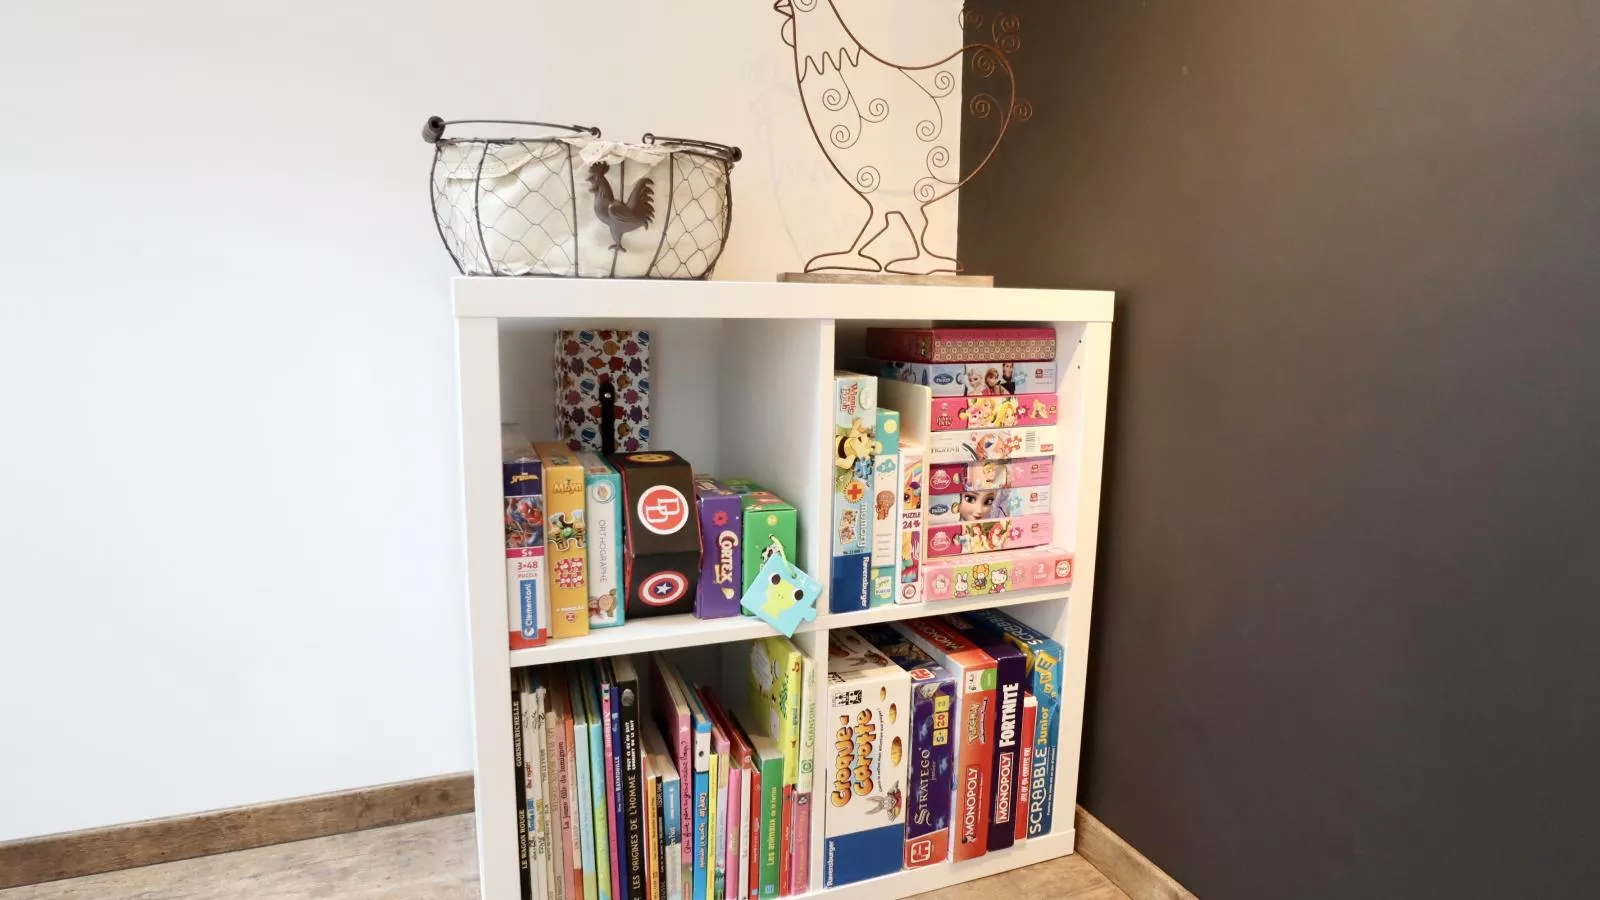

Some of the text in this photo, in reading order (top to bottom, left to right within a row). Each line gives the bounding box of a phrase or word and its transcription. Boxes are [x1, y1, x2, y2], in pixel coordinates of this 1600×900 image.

[903, 521, 912, 529] 24
[599, 519, 608, 583] ORTHOGRAPHE
[861, 557, 869, 607] Ravensburger
[805, 703, 815, 748] CHANSONS
[936, 714, 945, 727] 20
[999, 682, 1019, 747] FORTNITE
[914, 749, 931, 826] STRATEGO
[999, 756, 1012, 820] MONOPOLY
[1029, 706, 1049, 834] SCRABBLE Junior
[964, 767, 979, 836] MONOPOLY
[628, 774, 641, 889] LES ORIGINES DE L'HOMME
[766, 819, 776, 849] animaux
[522, 860, 528, 869] LE
[765, 851, 775, 866] Les
[827, 841, 835, 886] Ravensburger
